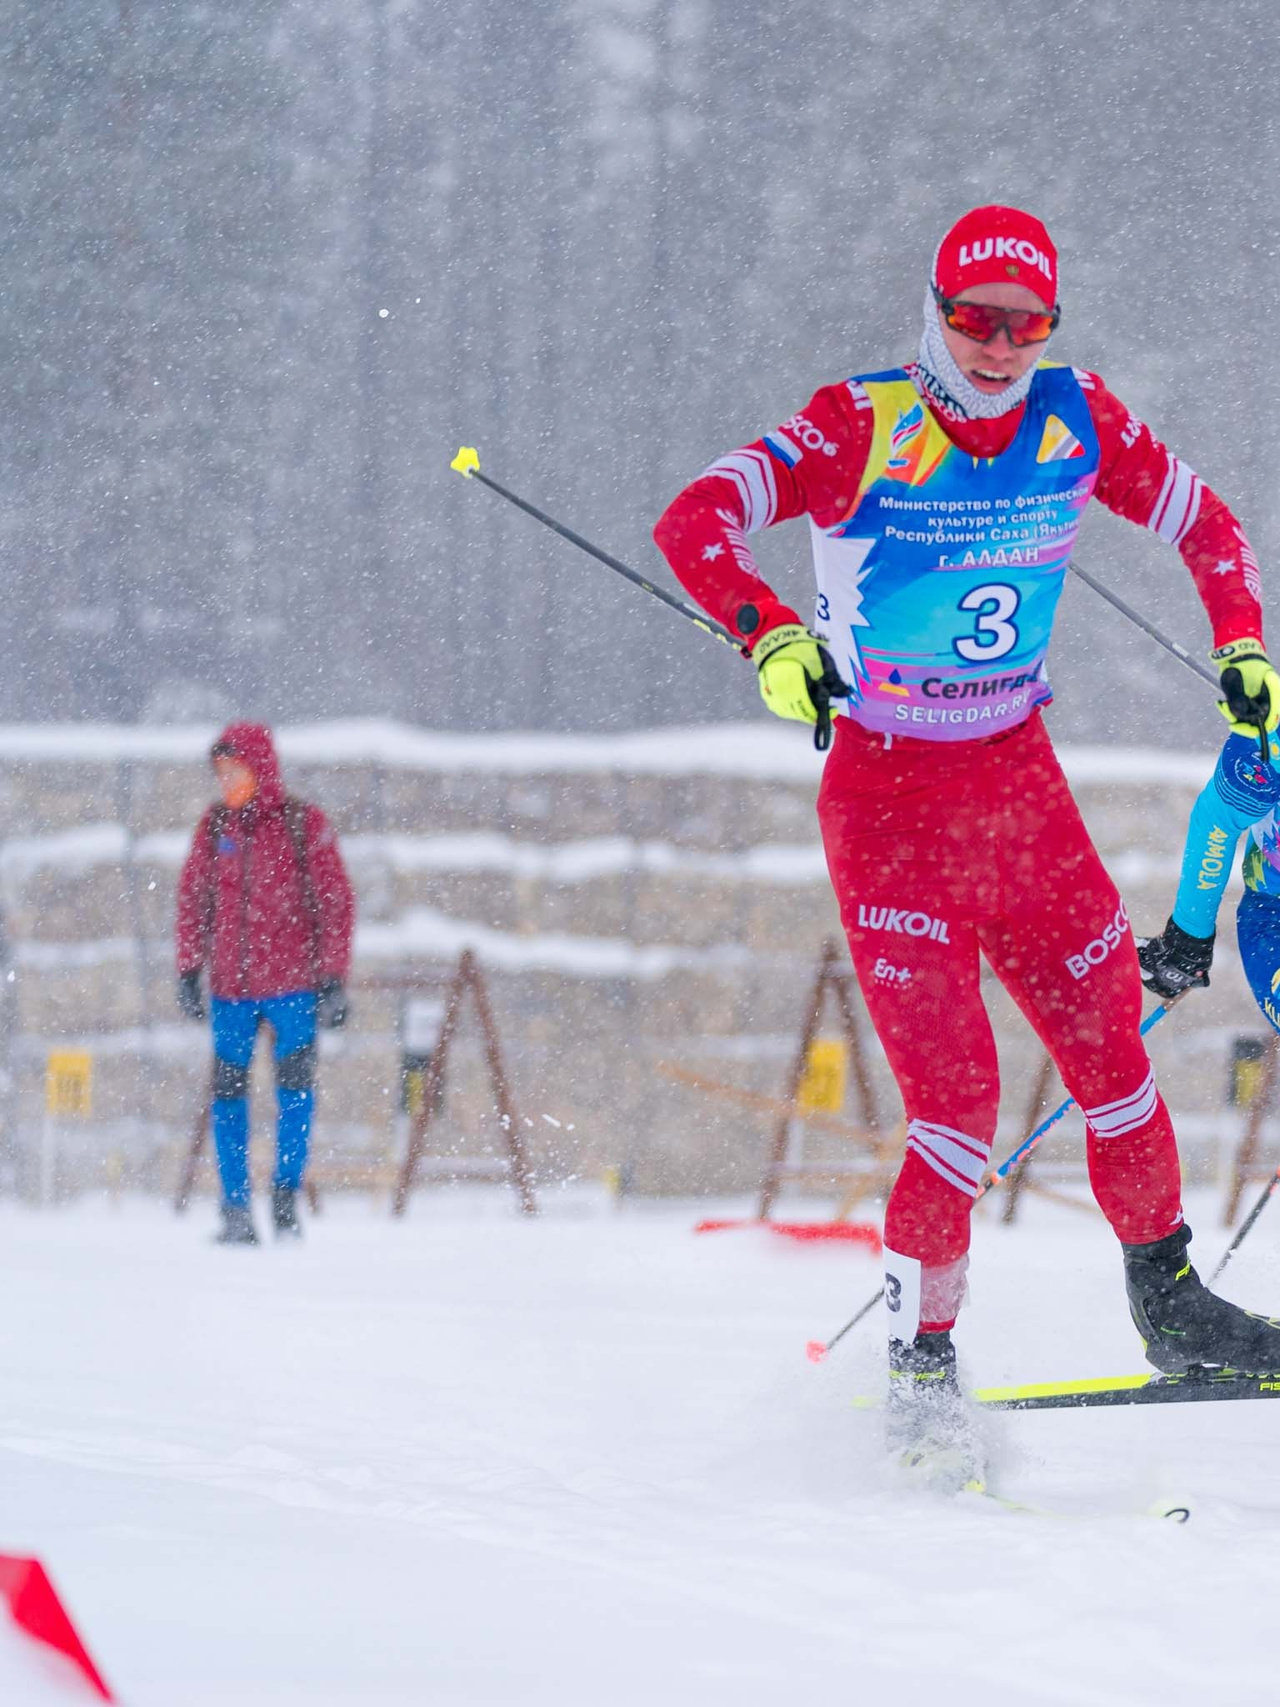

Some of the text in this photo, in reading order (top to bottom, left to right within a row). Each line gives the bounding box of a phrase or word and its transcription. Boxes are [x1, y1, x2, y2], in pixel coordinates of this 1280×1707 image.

[958, 237, 1053, 281] LUKOIL
[879, 497, 991, 513] Министерство
[995, 498, 1011, 509] по
[928, 510, 1058, 529] культуре и спорту
[885, 526, 985, 546] Республики
[990, 527, 1029, 542] Саха
[939, 547, 1039, 568] г. АЛДАН
[953, 582, 1021, 664] 3
[858, 904, 951, 945] LUKOIL
[885, 1272, 902, 1313] 3
